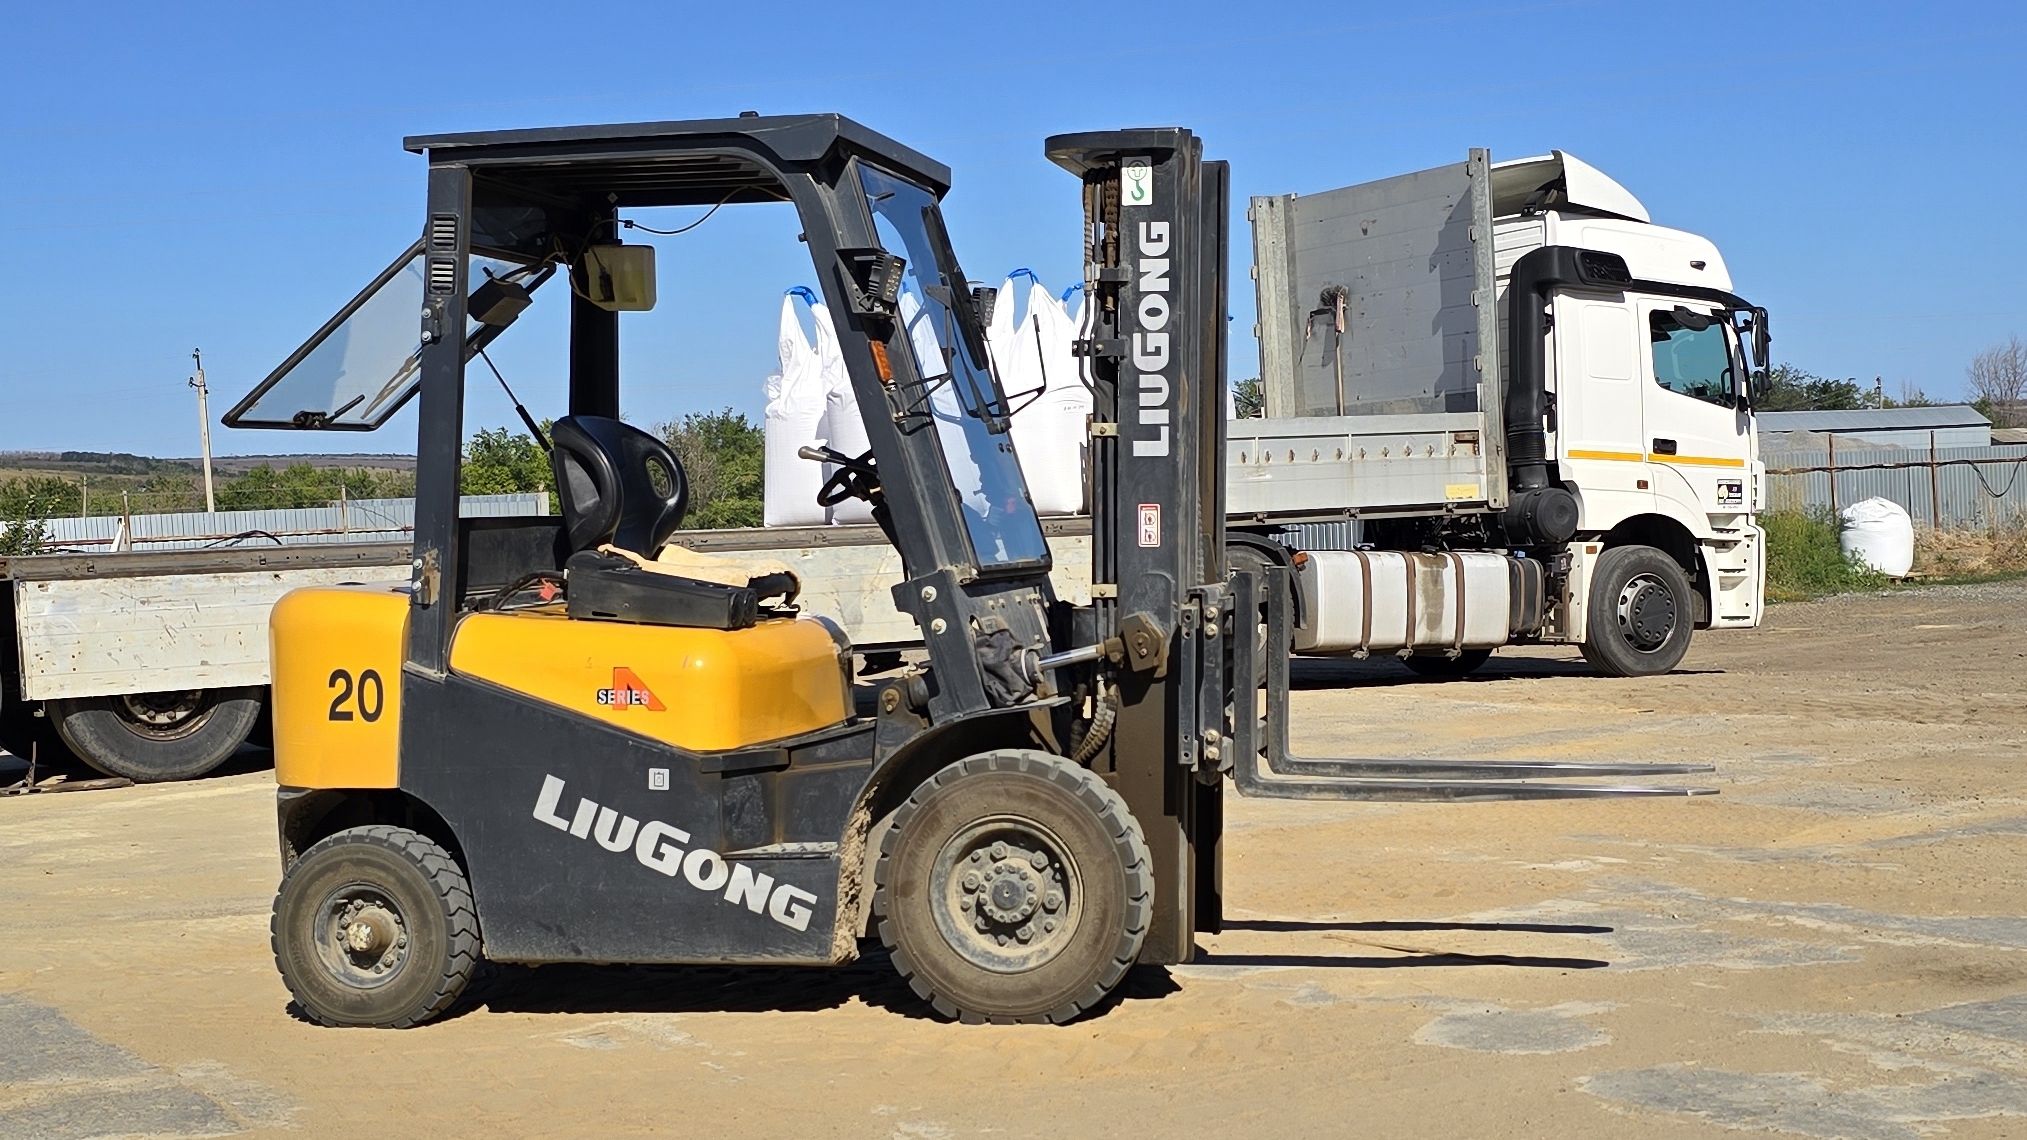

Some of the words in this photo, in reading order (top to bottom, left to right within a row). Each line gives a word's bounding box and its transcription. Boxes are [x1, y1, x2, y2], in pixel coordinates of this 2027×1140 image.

[1133, 221, 1170, 457] LIUGONG
[328, 668, 384, 722] 20
[598, 689, 649, 704] SERIES
